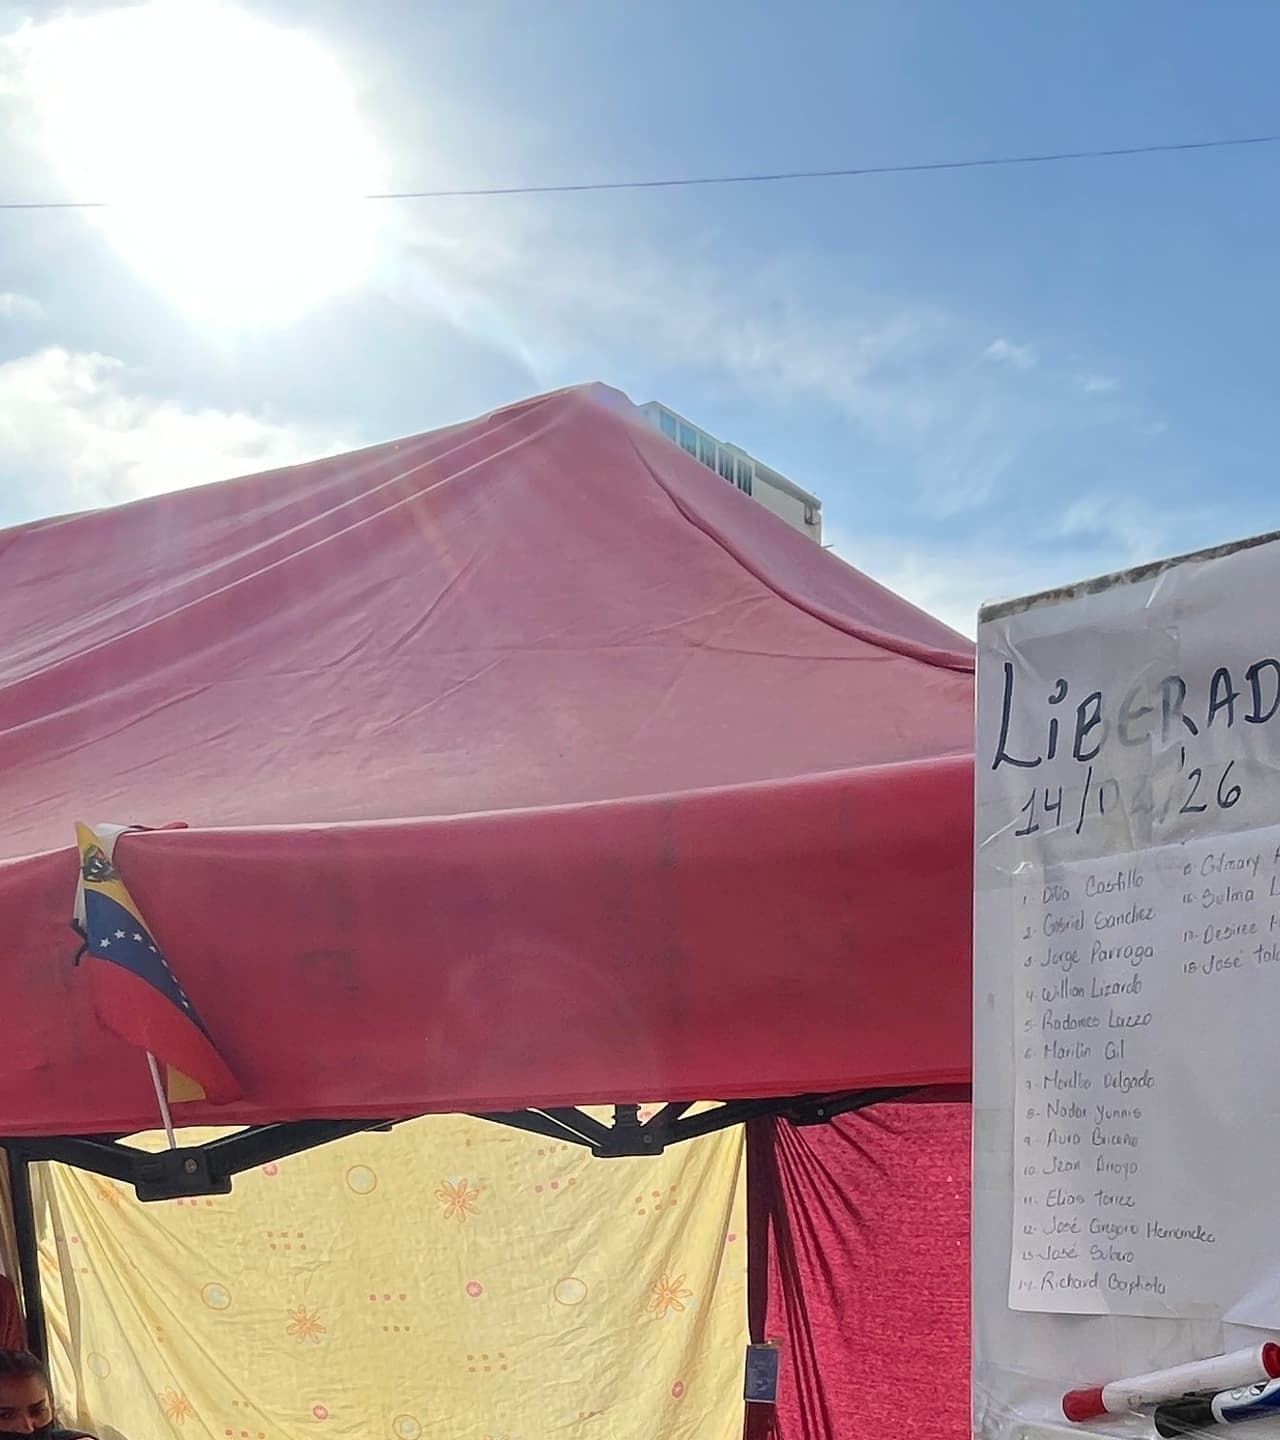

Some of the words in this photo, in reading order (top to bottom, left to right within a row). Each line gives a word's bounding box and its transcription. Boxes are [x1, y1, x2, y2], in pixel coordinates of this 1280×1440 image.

[1086, 868, 1144, 898] Castillo
[1041, 948, 1081, 973] Jorge
[1104, 1039, 1125, 1060] Gil
[1103, 1069, 1155, 1093] Delgado
[1041, 1270, 1099, 1291] Richard
